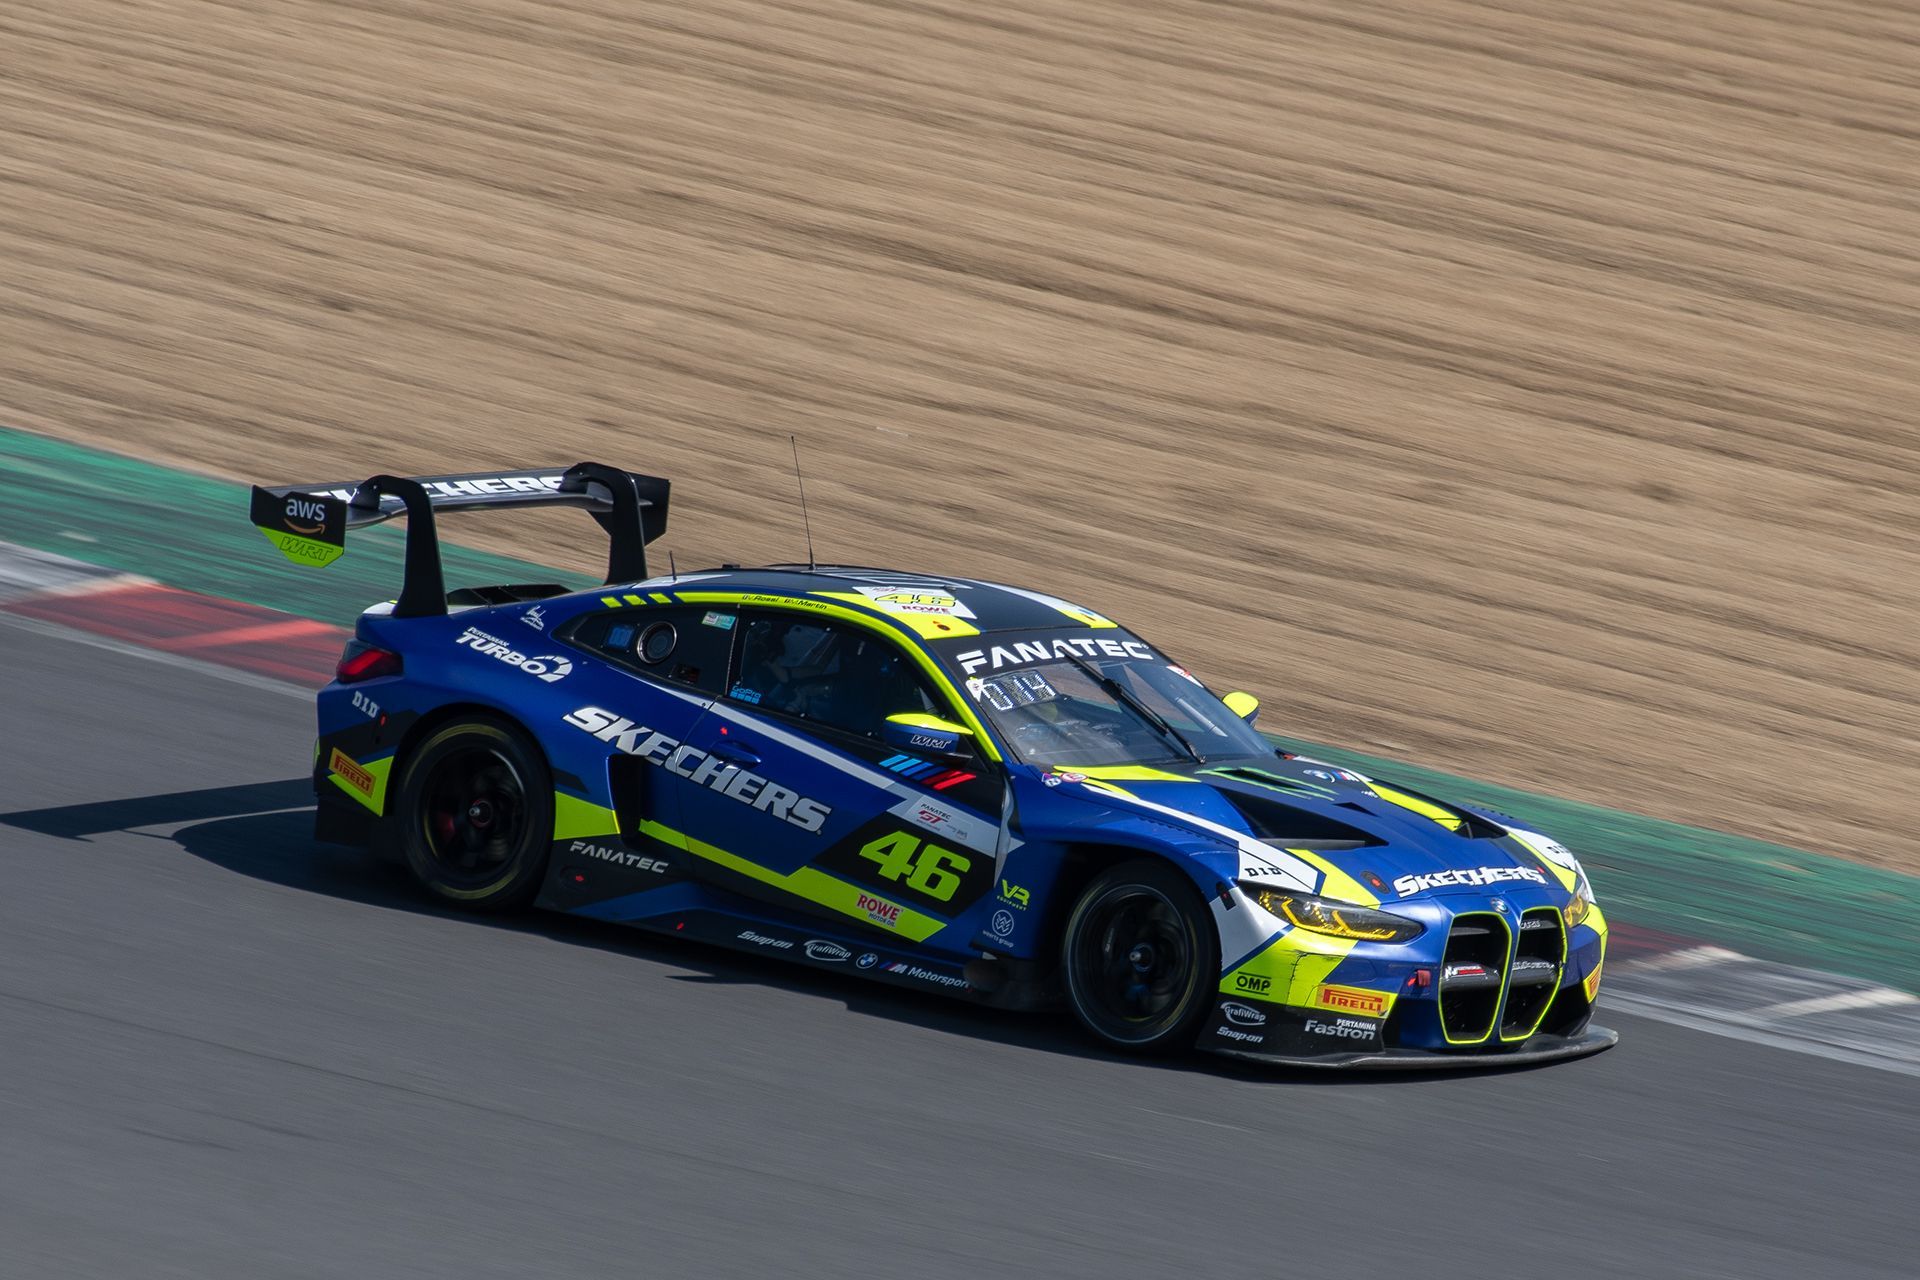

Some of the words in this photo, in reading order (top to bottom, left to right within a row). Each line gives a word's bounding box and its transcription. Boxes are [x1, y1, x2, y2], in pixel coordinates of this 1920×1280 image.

[285, 498, 326, 522] aws
[279, 536, 334, 561] WRT
[874, 593, 956, 607] 46
[956, 638, 1154, 675] FANATEC
[333, 753, 373, 793] PIRELLI
[561, 706, 832, 834] SKECHERS
[920, 803, 952, 820] FANATEC
[569, 840, 670, 874] FANATEC
[859, 830, 971, 902] 46
[1001, 878, 1031, 906] VR
[1393, 866, 1549, 898] SKECHERS
[857, 893, 900, 921] ROWE
[736, 930, 795, 949] Snap-on
[1236, 974, 1271, 992] OMP
[1322, 988, 1384, 1012] PIRELLI
[1224, 1005, 1267, 1023] GrafiWrap
[1336, 1018, 1377, 1032] PERTAMINA
[1216, 1026, 1264, 1044] Snap-on
[1304, 1019, 1376, 1041] Fastron
